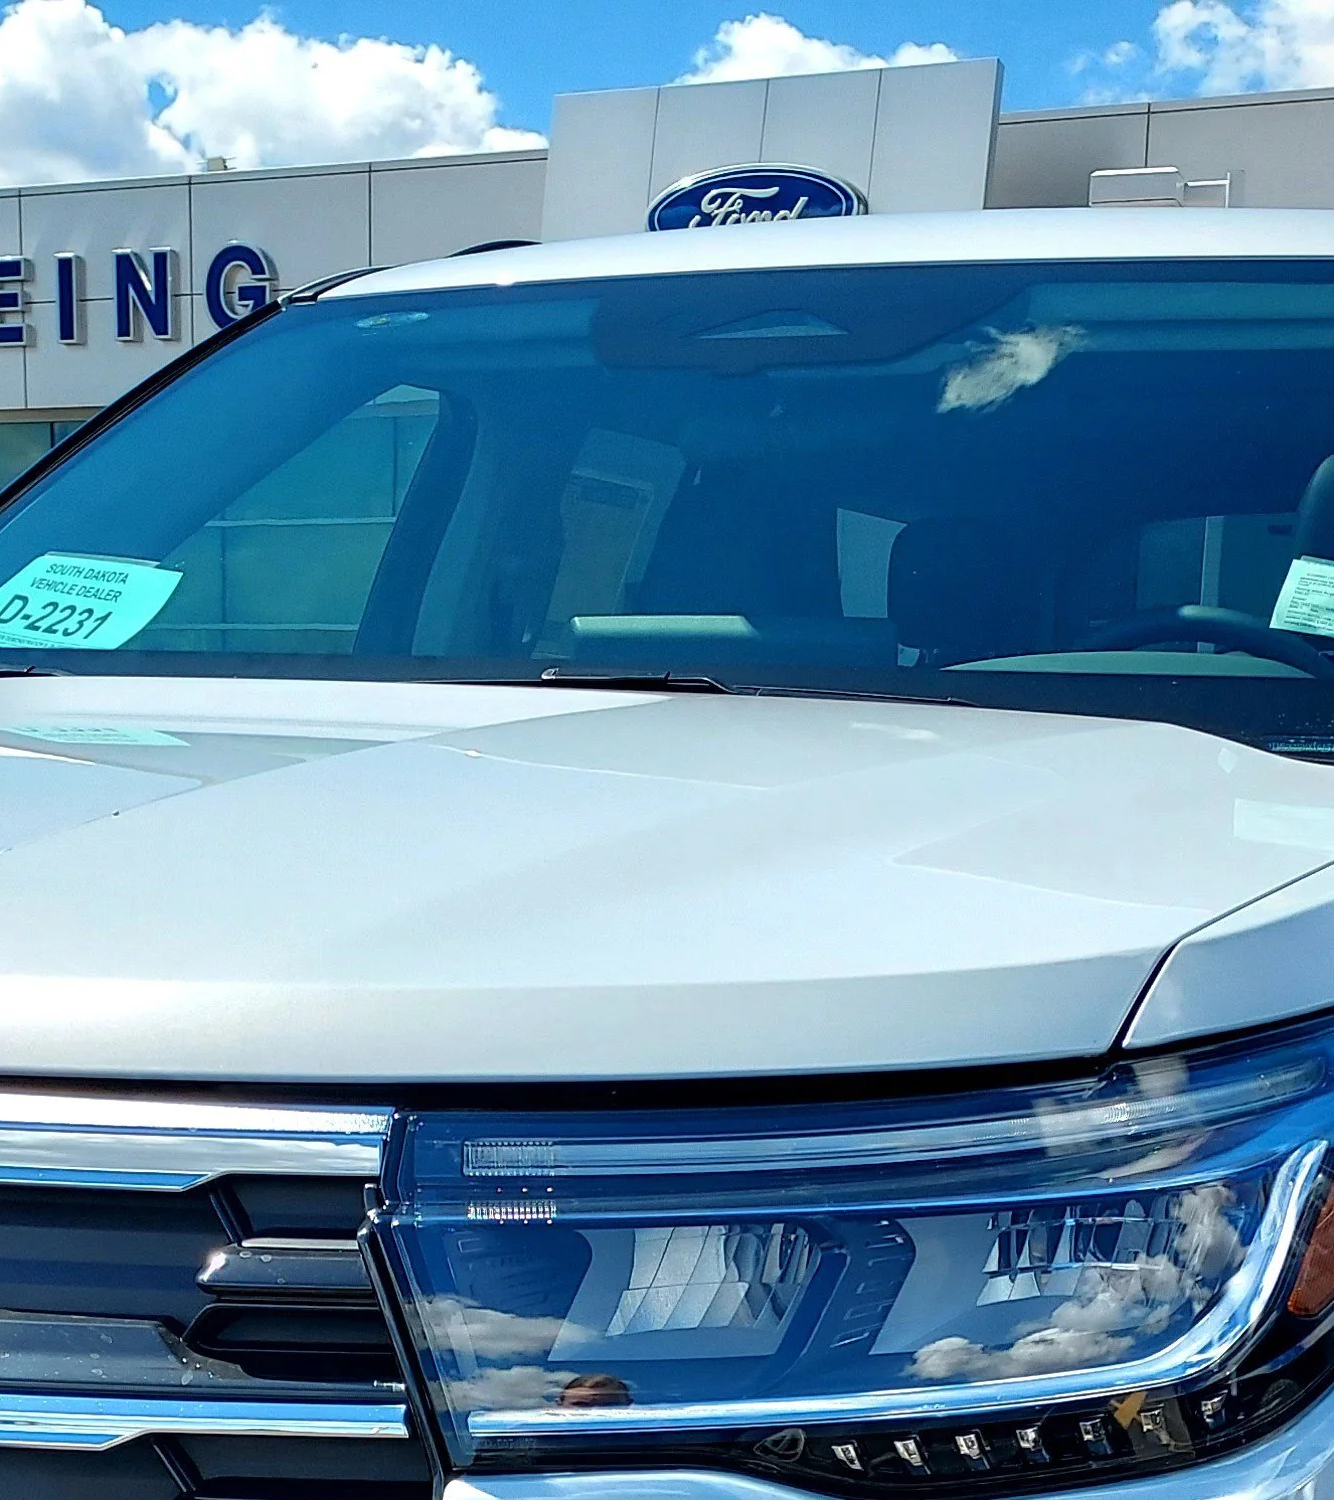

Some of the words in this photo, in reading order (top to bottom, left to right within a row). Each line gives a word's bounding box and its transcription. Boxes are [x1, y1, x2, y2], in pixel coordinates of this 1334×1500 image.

[46, 563, 83, 579] SOUTH
[83, 569, 129, 585] DAKOTA
[30, 577, 76, 596] VEHICLE
[76, 586, 122, 603] DEALER
